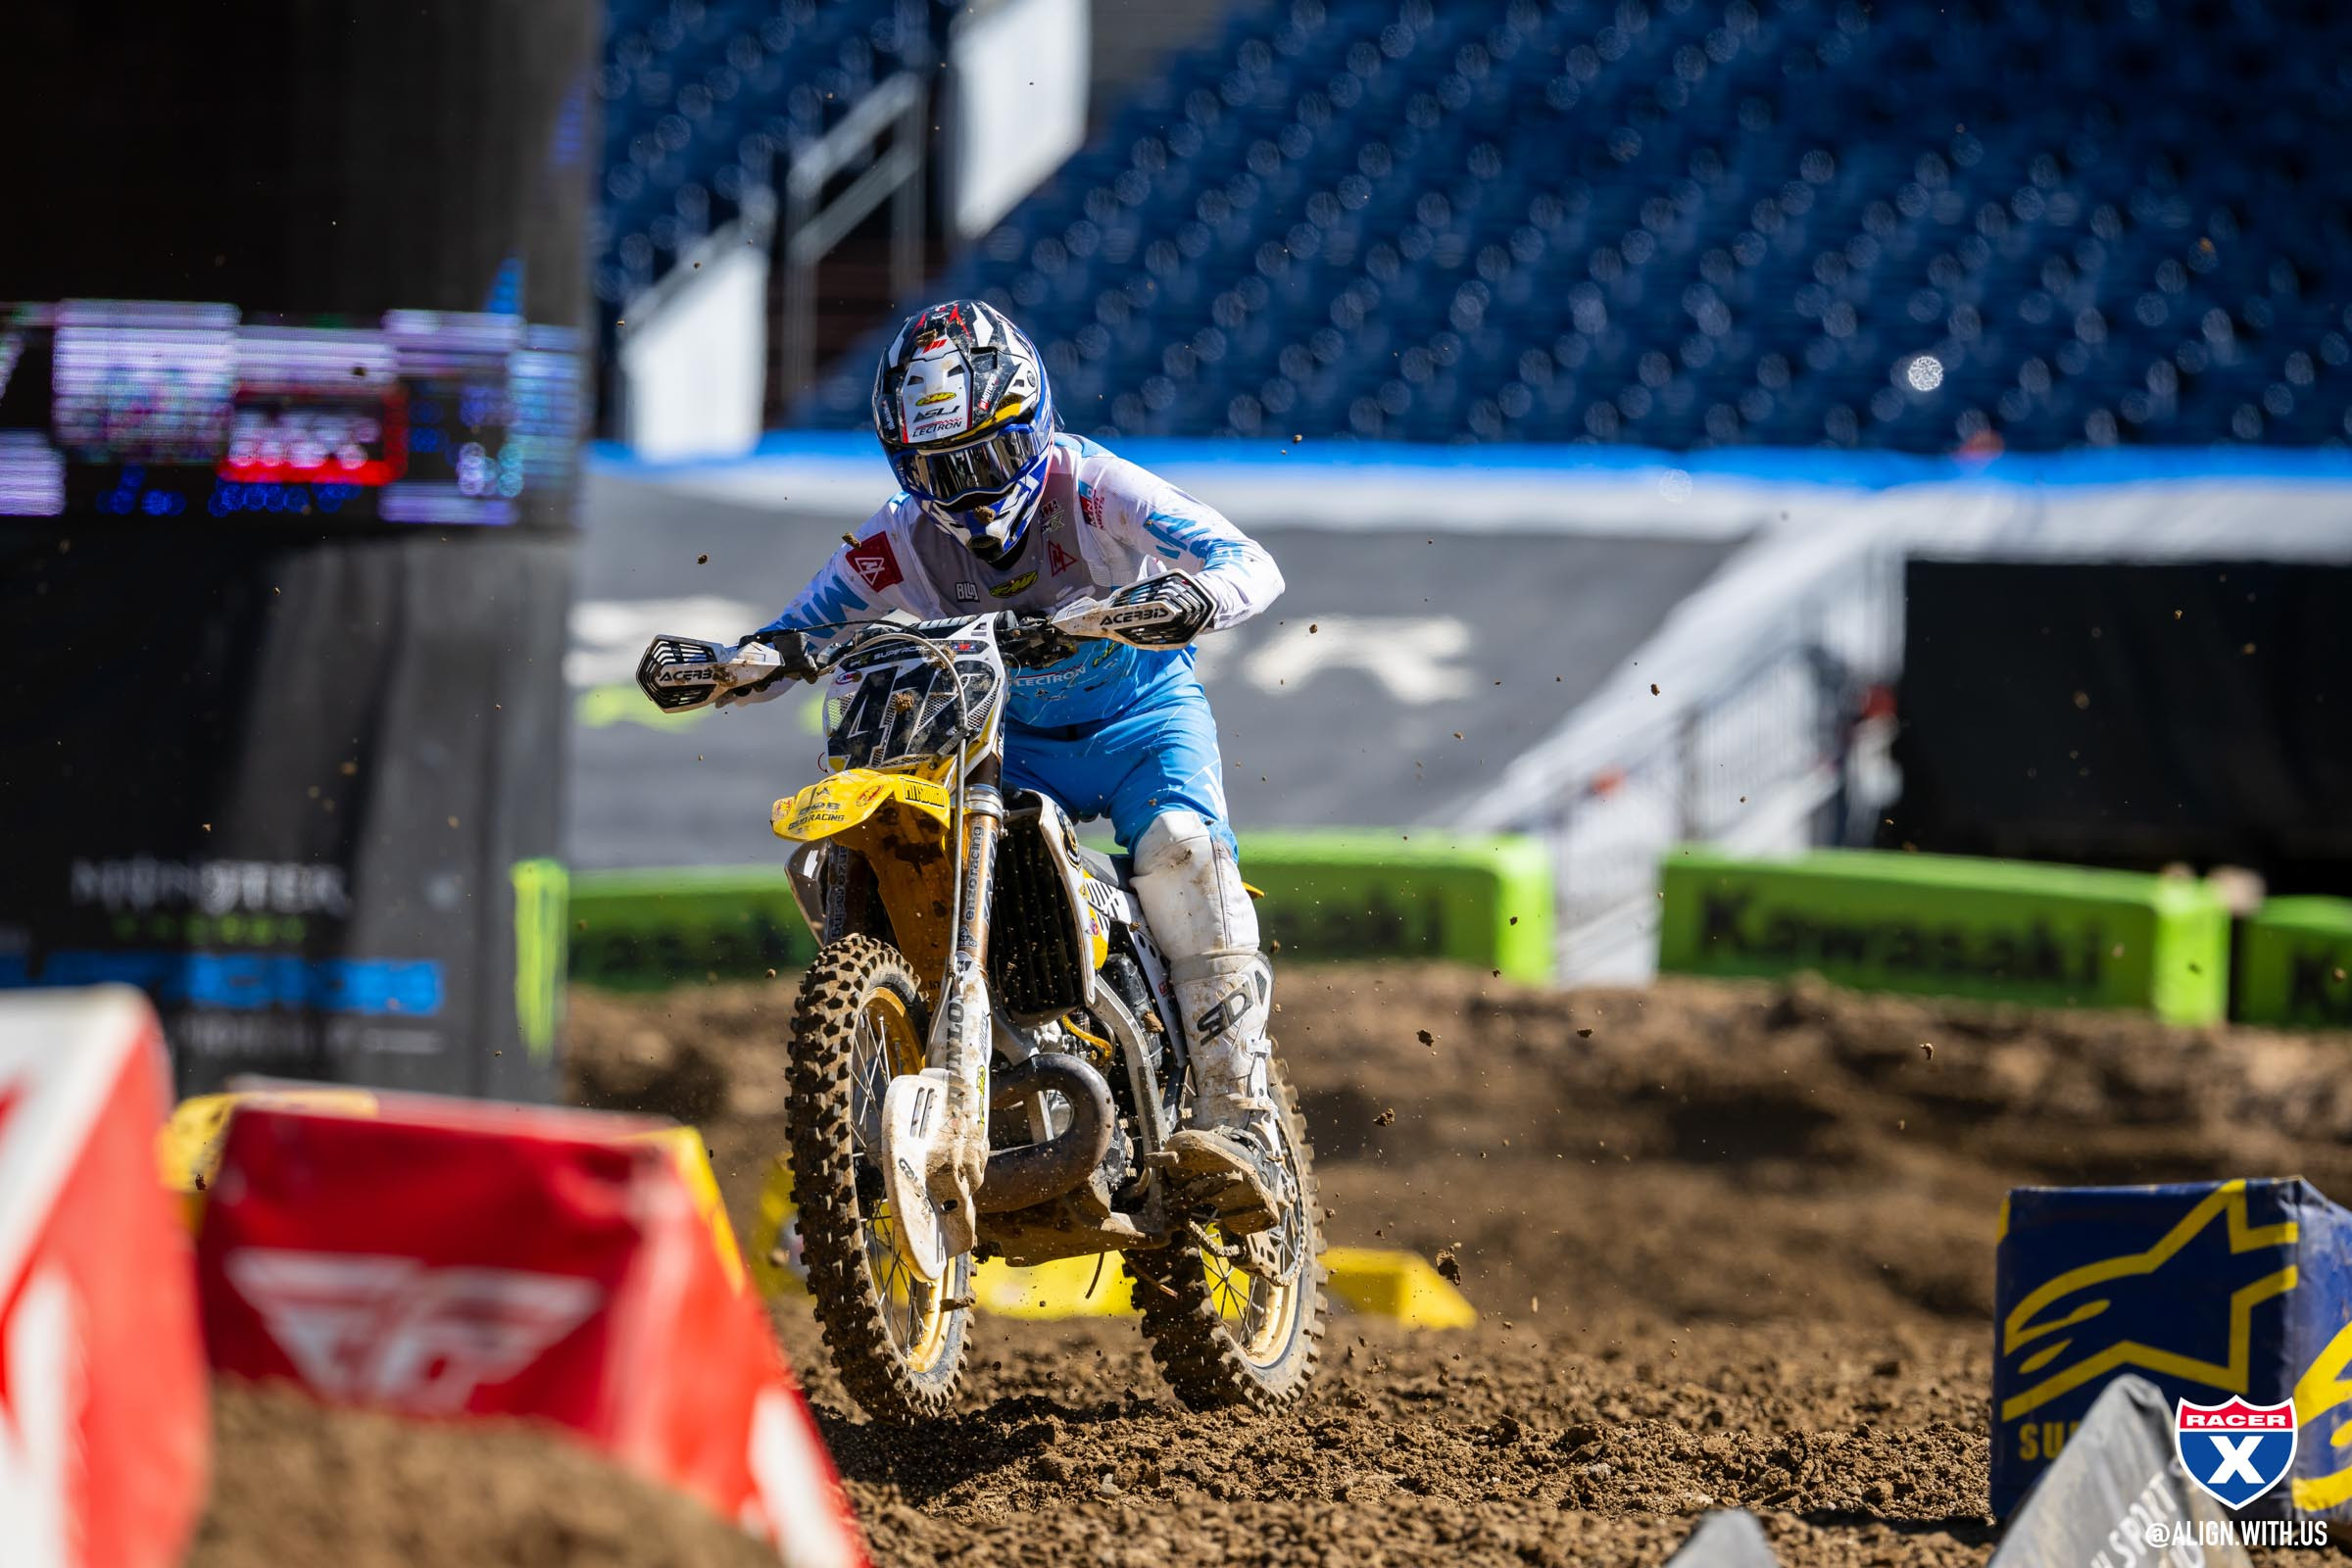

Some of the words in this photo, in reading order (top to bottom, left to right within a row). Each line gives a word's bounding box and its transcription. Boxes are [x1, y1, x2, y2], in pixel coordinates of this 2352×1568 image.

[912, 420, 962, 438] LECTRON
[1099, 607, 1169, 626] ACERBIS
[659, 669, 714, 682] ACERB
[1698, 885, 2103, 985] Kawasaki
